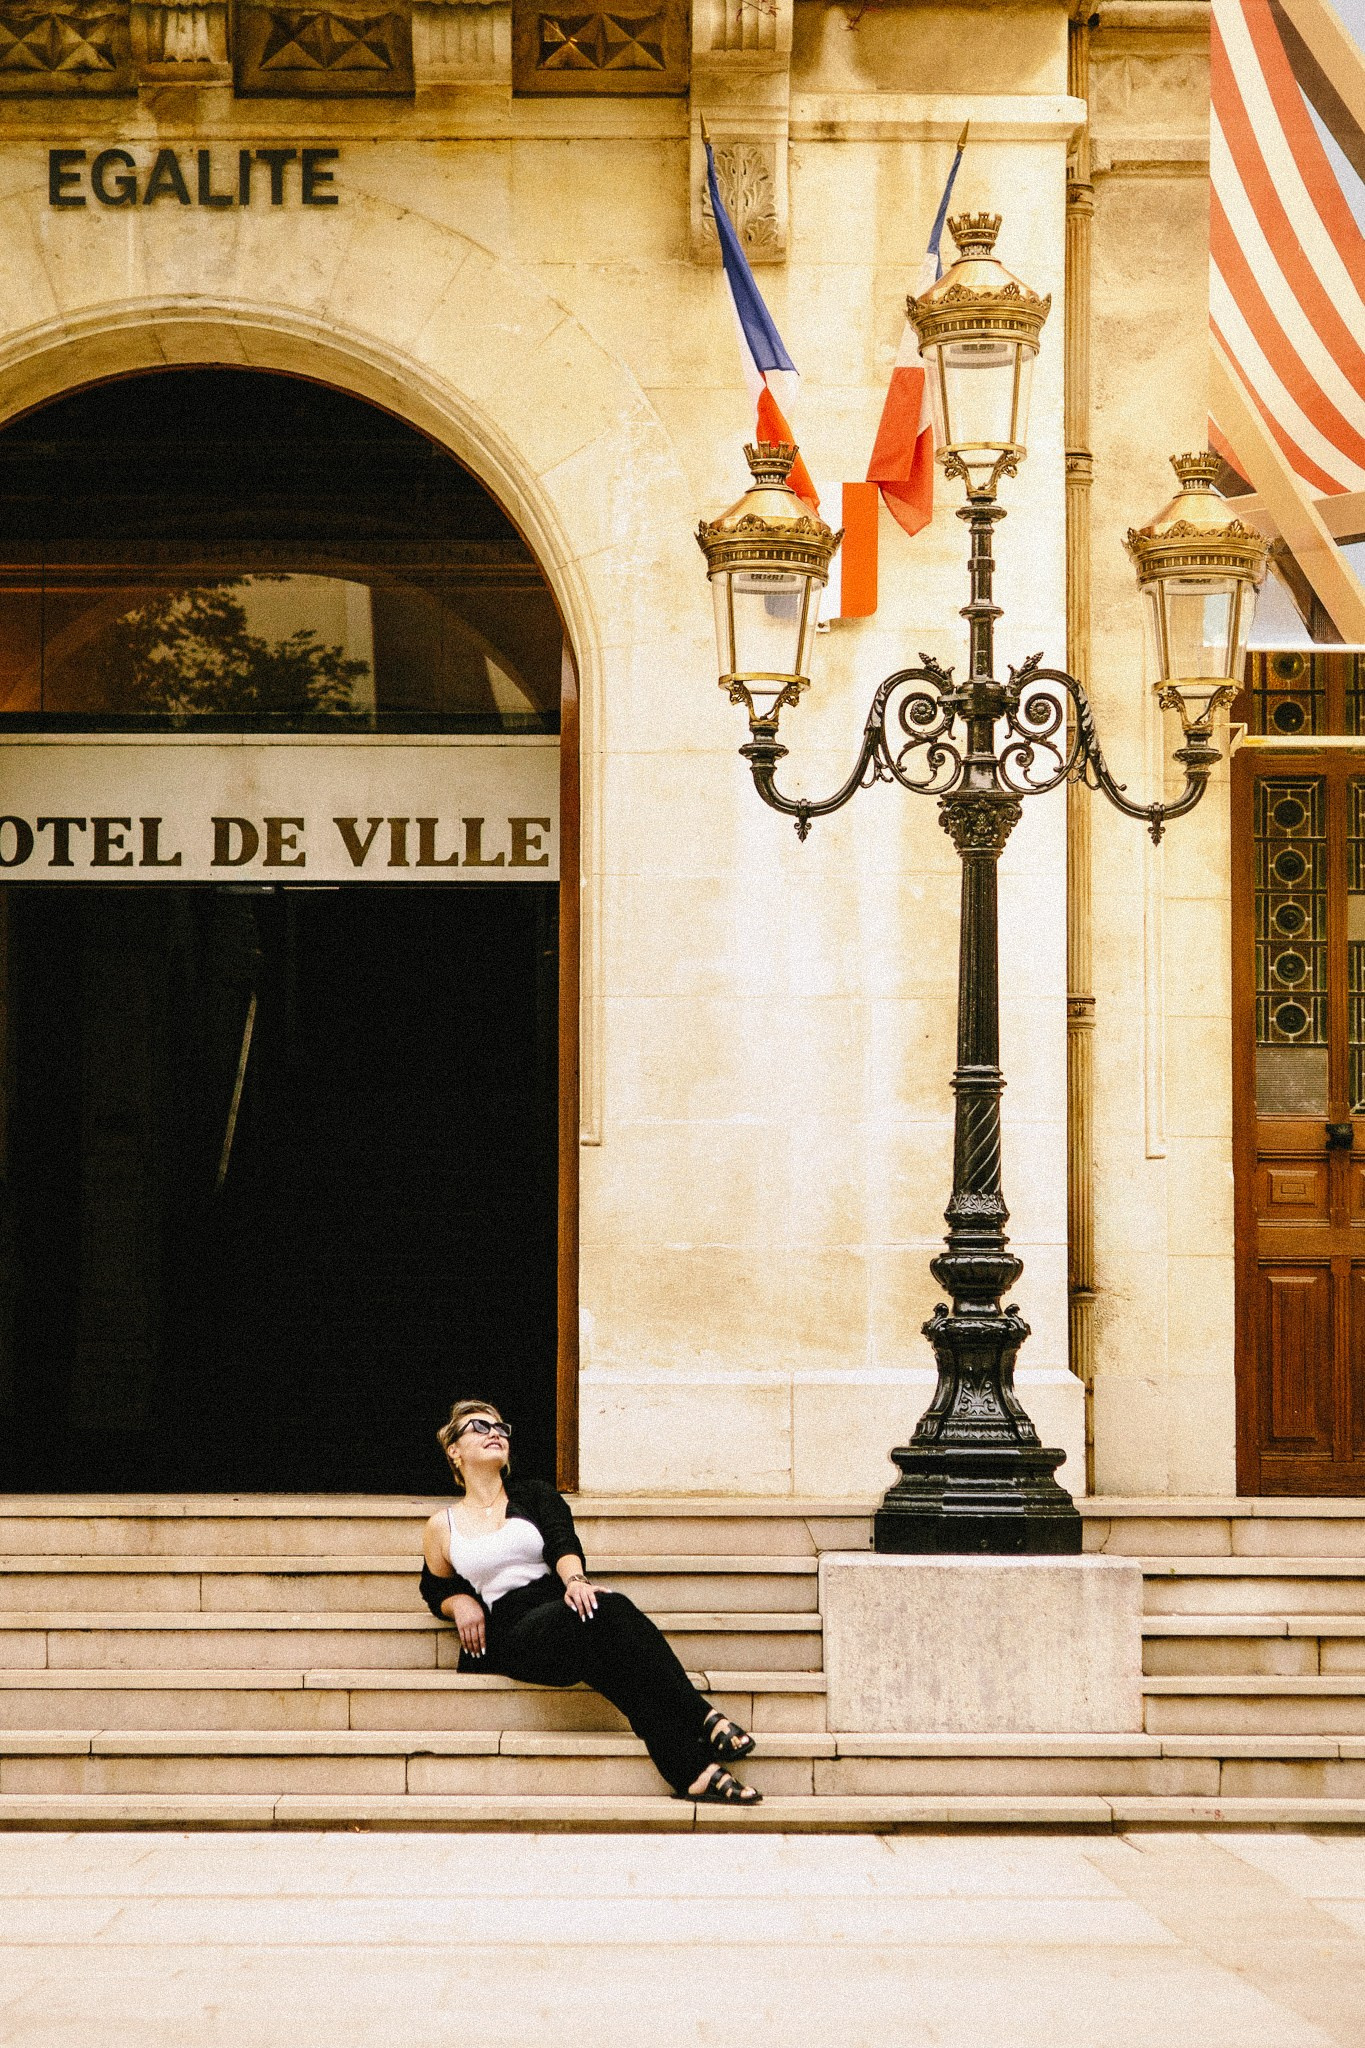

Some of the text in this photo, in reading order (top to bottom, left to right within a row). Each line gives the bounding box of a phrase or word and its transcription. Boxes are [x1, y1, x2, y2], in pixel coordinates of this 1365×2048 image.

[49, 148, 339, 206] EGALITE
[210, 817, 306, 867] DE
[332, 817, 551, 867] VILLE
